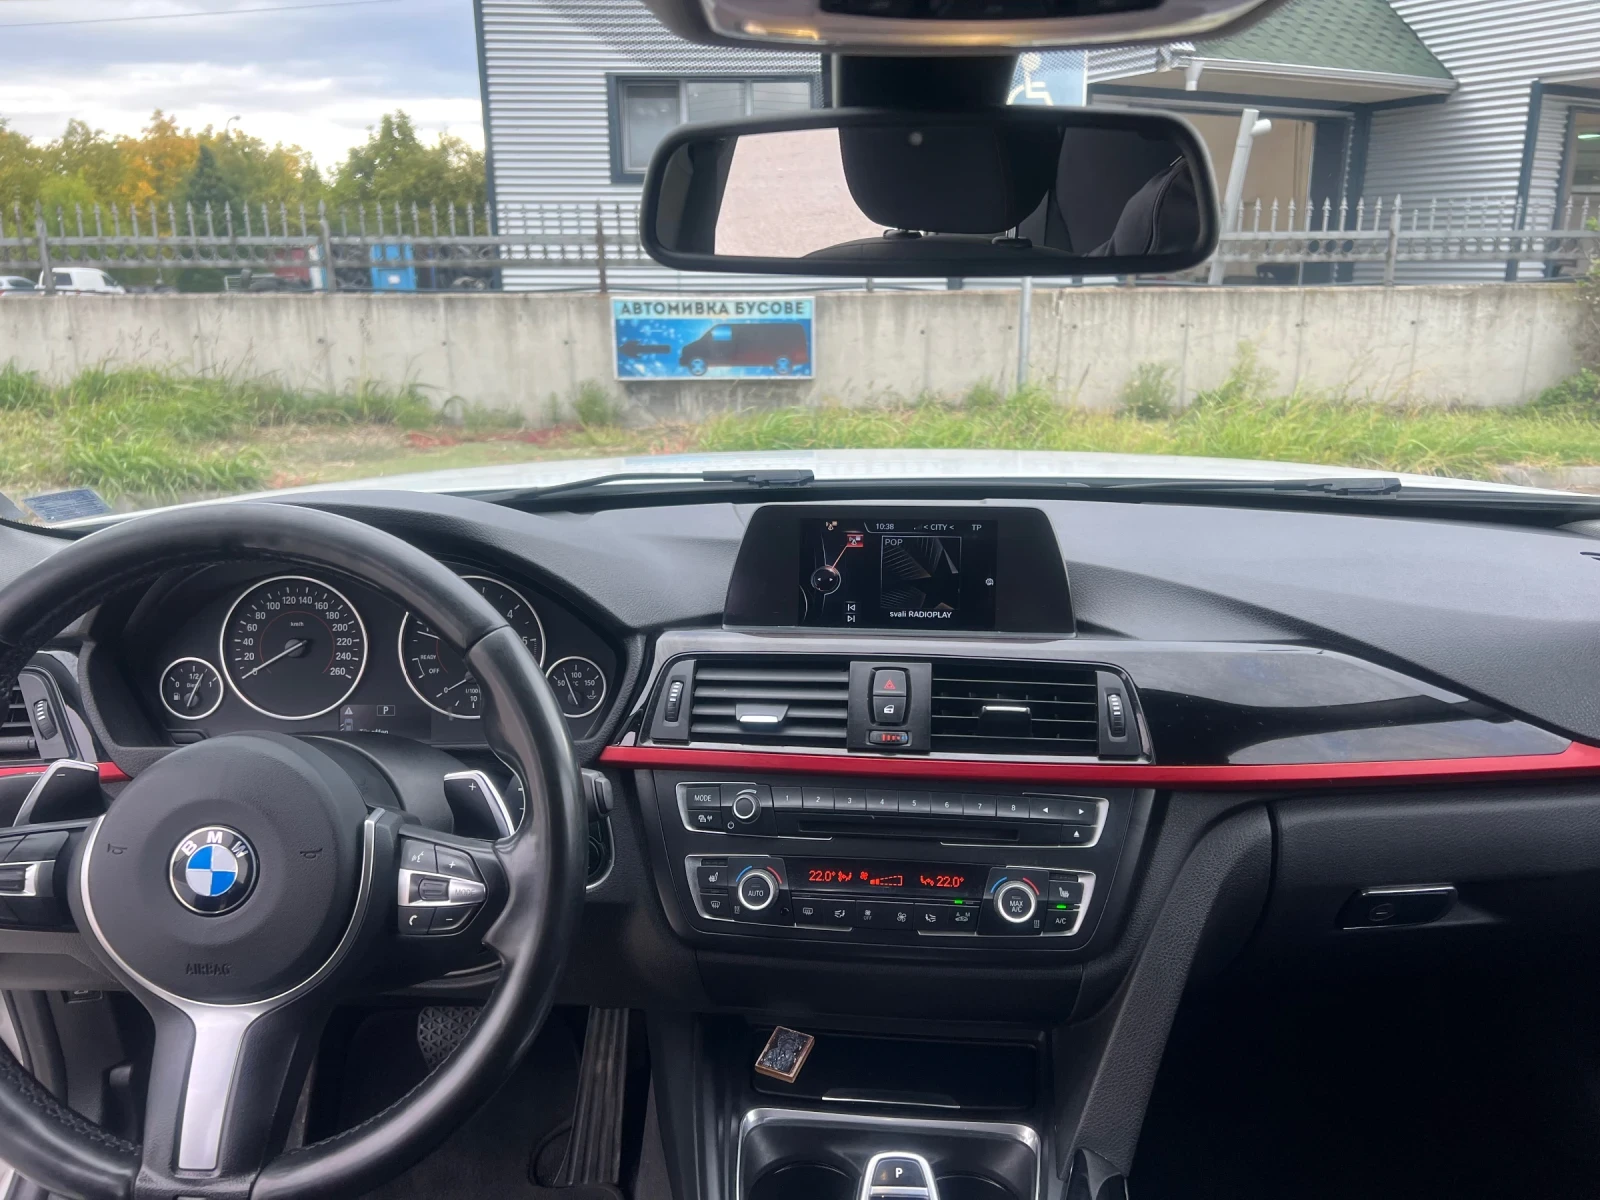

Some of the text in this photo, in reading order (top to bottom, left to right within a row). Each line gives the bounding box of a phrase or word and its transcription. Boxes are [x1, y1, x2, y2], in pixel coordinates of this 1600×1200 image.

[621, 301, 805, 315] АВТОМИВКА БУСОВЕ
[930, 523, 947, 531] CITY
[884, 538, 903, 546] POP
[282, 596, 297, 605] 120
[298, 596, 313, 605] 140
[266, 602, 281, 610] 100
[314, 602, 329, 610] 160
[255, 612, 266, 620] 80
[325, 612, 340, 620] 180
[506, 609, 514, 619] 4
[908, 611, 952, 619] RADIOPLAY
[246, 623, 258, 632] 60
[332, 623, 348, 632] 200
[242, 637, 254, 646] 40
[336, 637, 352, 646] 220
[244, 652, 255, 661] 20
[335, 651, 352, 661] 240
[330, 667, 346, 676] 260
[383, 706, 389, 715] P
[694, 794, 712, 802] MODE
[879, 798, 885, 806] 4
[912, 799, 917, 807] 5
[944, 801, 950, 809] 6
[1011, 804, 1016, 812] 8
[181, 830, 249, 859] BMW
[747, 889, 764, 897] AUTO
[1055, 917, 1067, 925] A/C
[185, 962, 231, 975] AIRBAG
[895, 1167, 903, 1178] P
